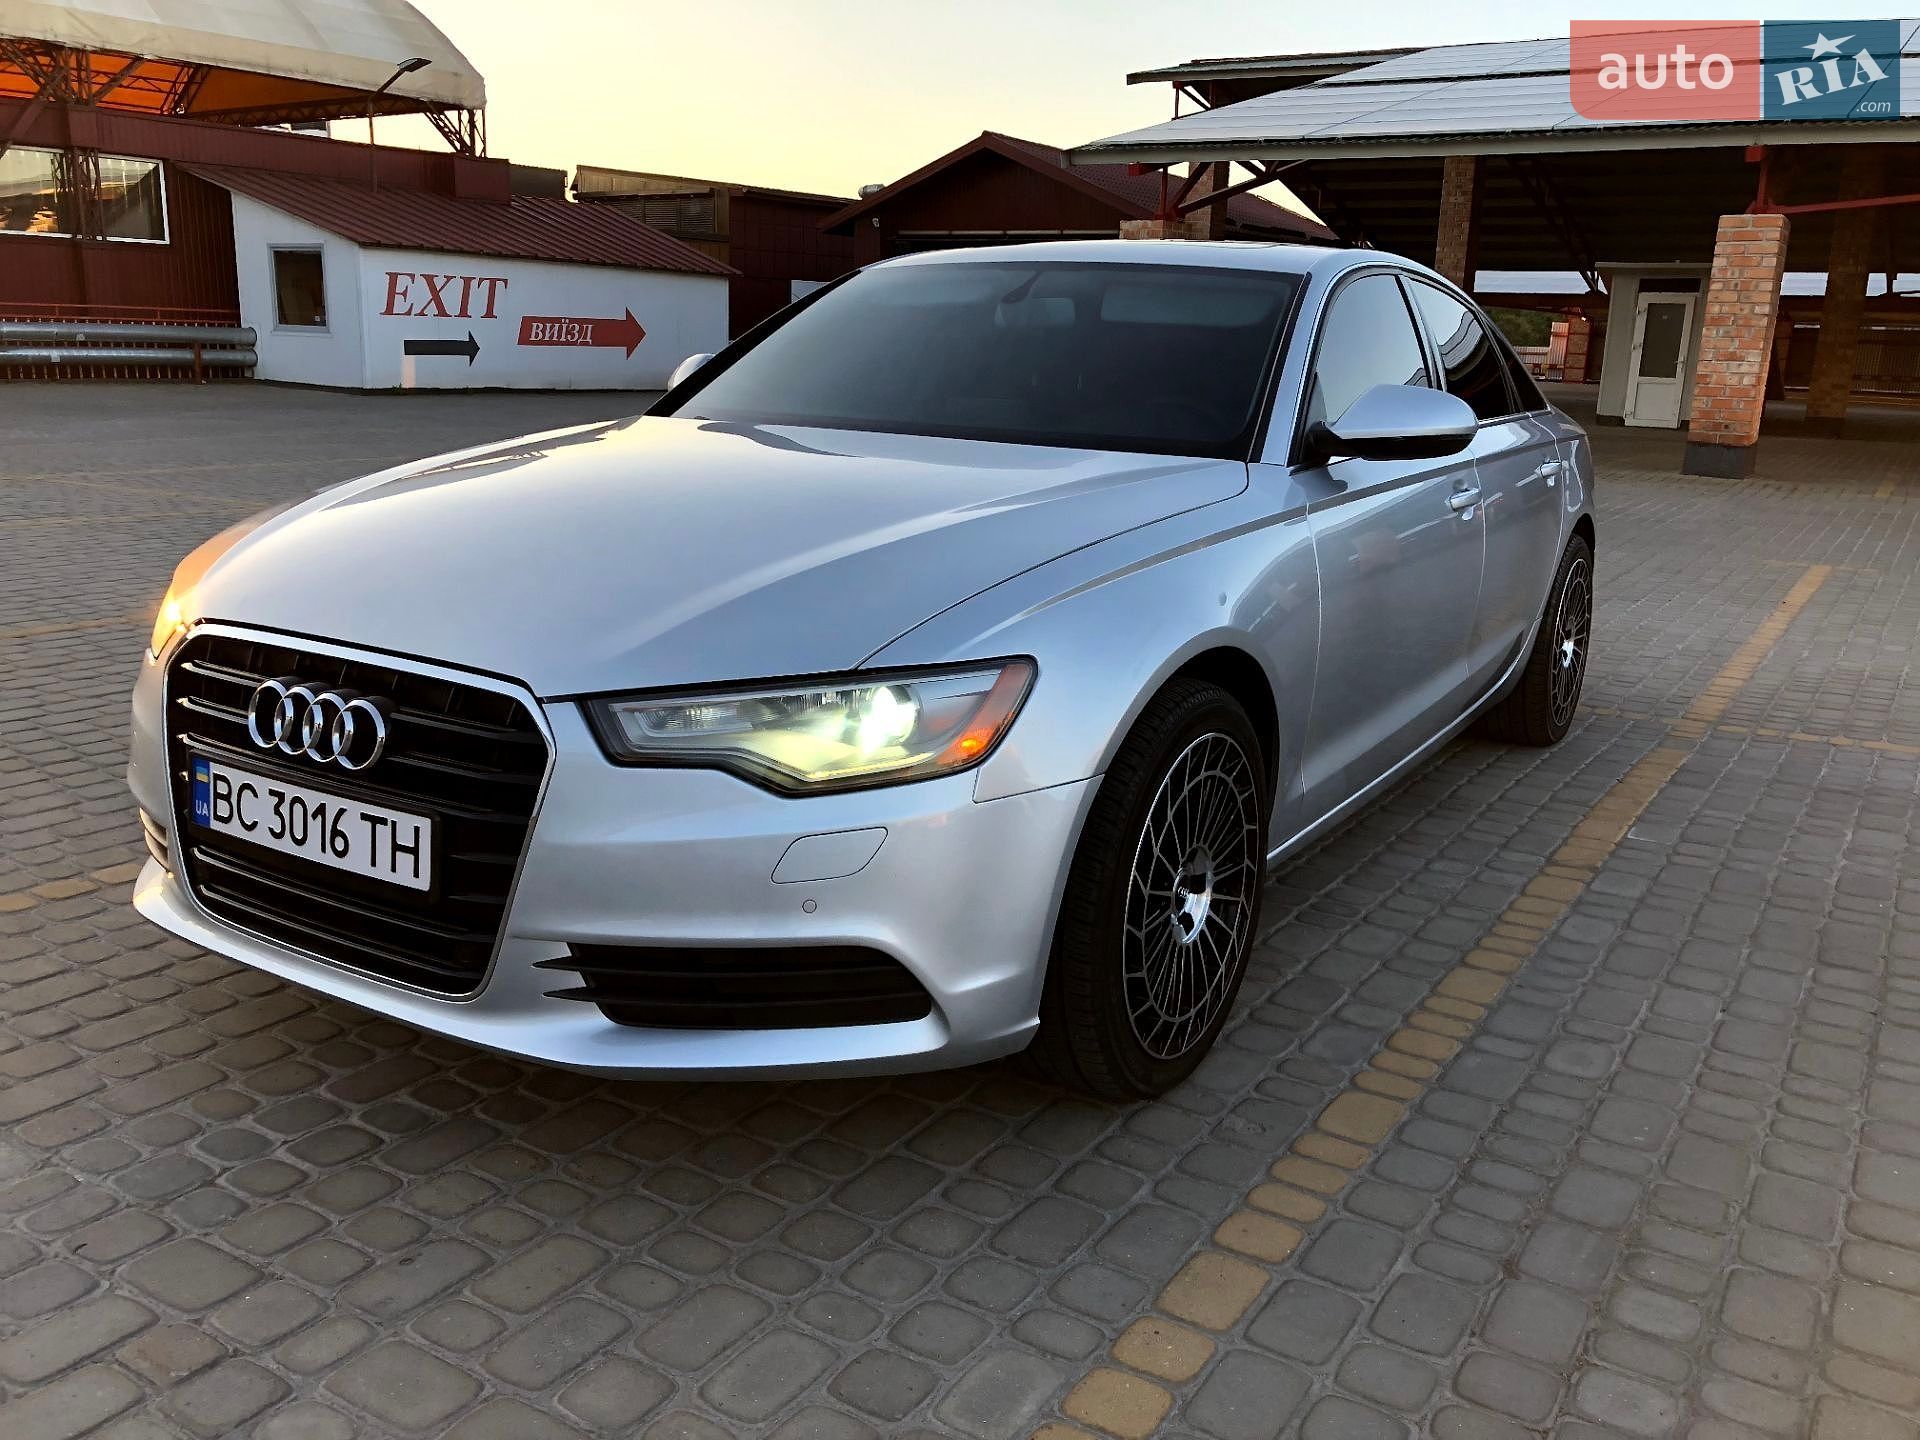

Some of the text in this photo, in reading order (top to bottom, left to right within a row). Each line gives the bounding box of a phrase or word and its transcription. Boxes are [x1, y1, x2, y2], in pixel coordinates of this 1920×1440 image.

[379, 272, 508, 319] EXIT
[529, 318, 593, 344] ВИЇЗД
[195, 801, 209, 817] UA
[268, 788, 350, 859] 3016
[360, 812, 421, 879] TH
